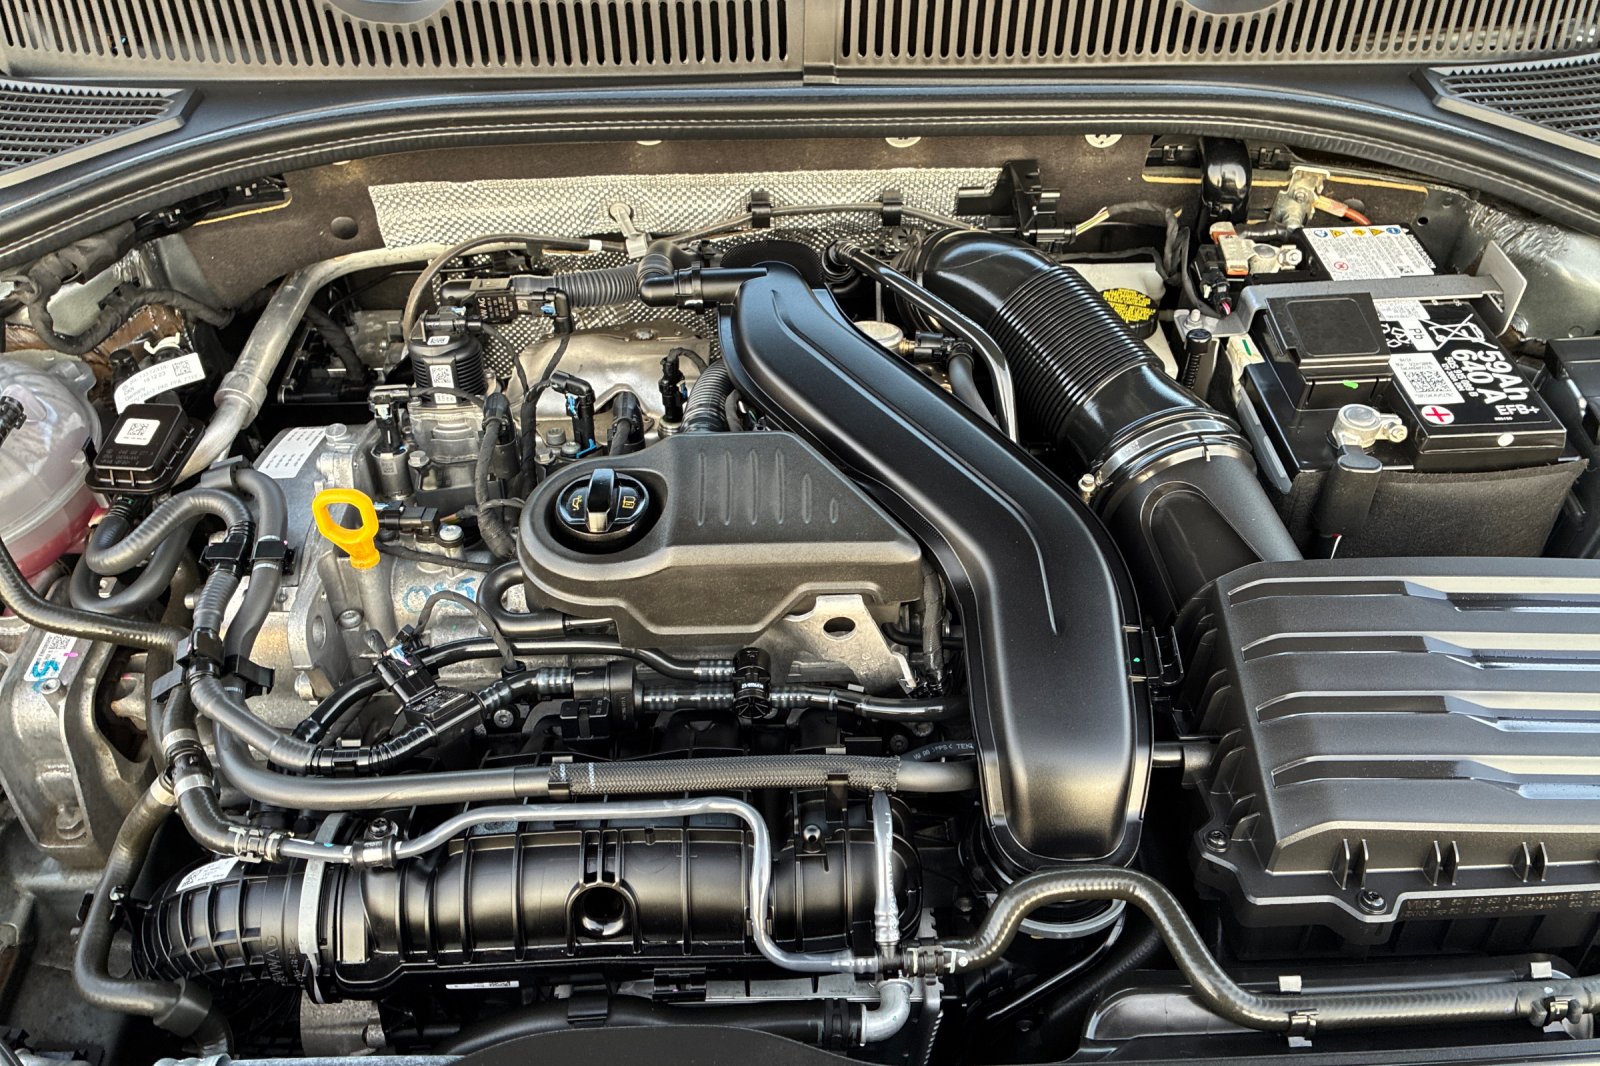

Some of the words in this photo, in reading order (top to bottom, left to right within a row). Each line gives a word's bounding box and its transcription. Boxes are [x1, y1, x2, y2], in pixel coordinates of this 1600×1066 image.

[1408, 328, 1424, 340] Pb
[1451, 349, 1495, 384] 640
[1476, 388, 1508, 404] A
[1477, 350, 1530, 401] 59Ah
[1495, 403, 1540, 416] EFB+
